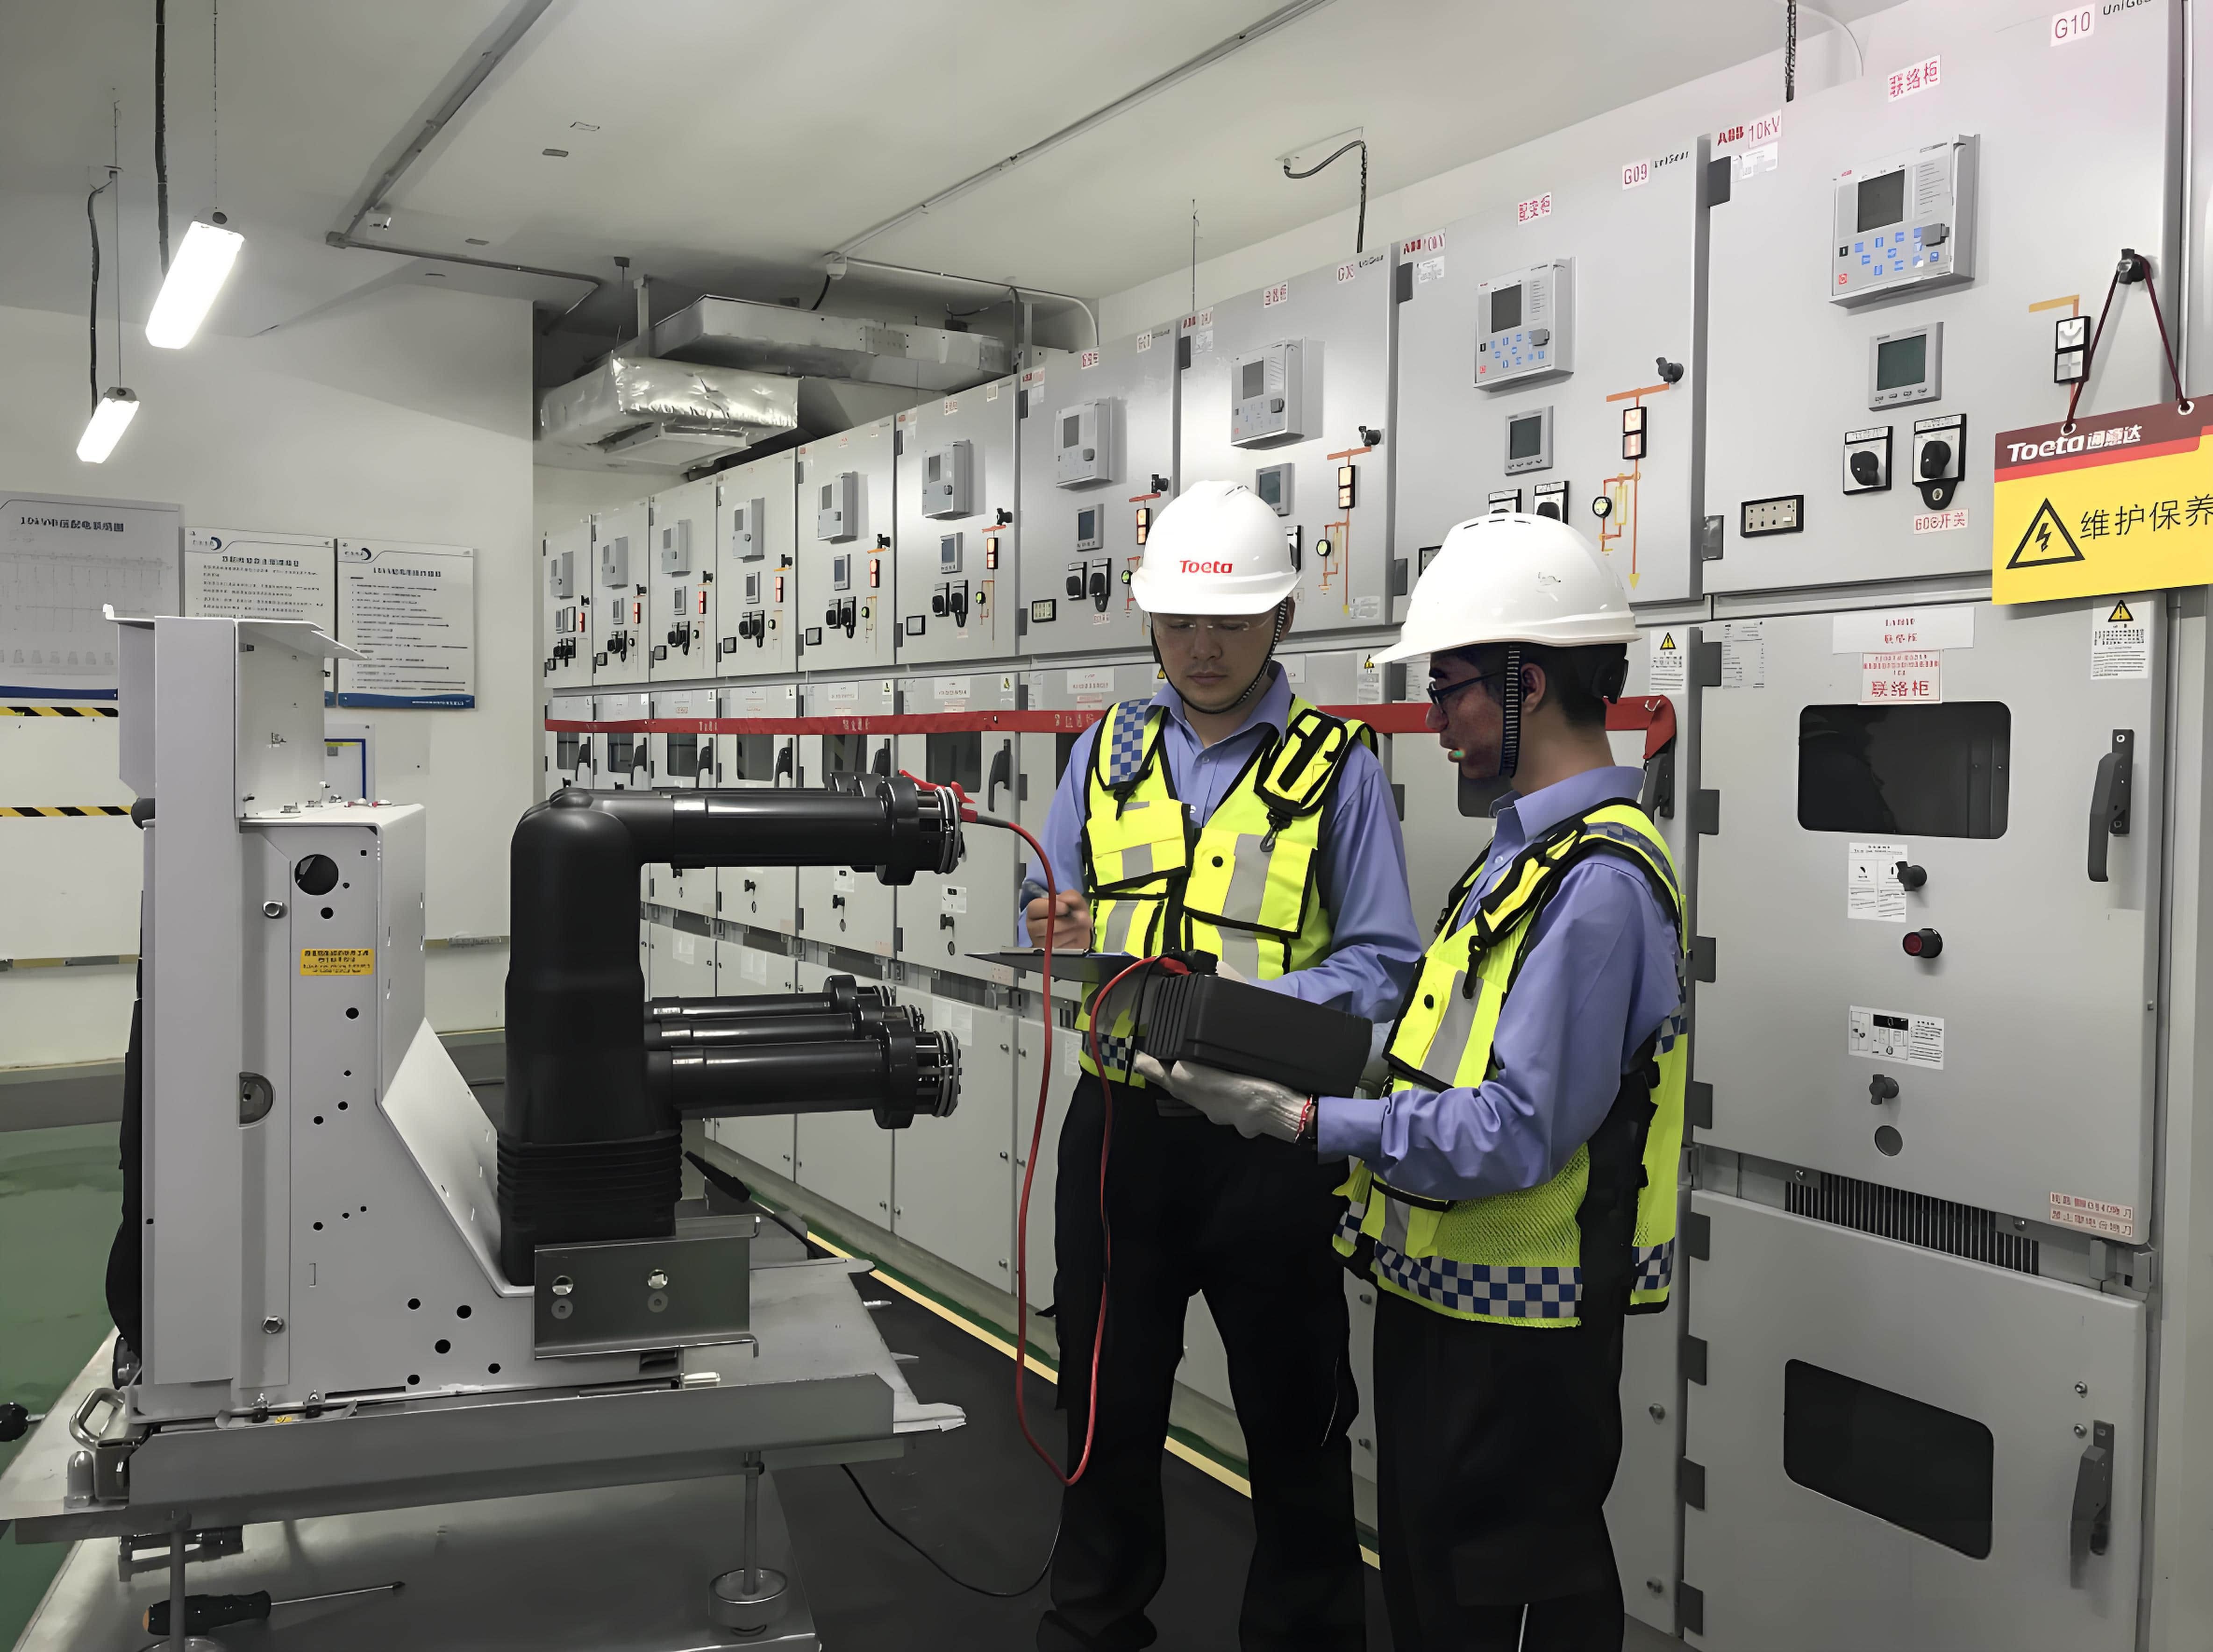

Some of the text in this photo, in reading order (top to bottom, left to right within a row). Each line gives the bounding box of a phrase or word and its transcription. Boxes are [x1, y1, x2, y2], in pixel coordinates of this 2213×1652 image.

[2055, 11, 2090, 38] G10
[1749, 115, 1780, 142] 10kV
[1624, 164, 1647, 185] G09
[2006, 435, 2084, 462] Toeta
[2080, 494, 2213, 540] 维护保养
[1179, 560, 1233, 574] Toeta
[1871, 680, 1929, 697] 联络柜
